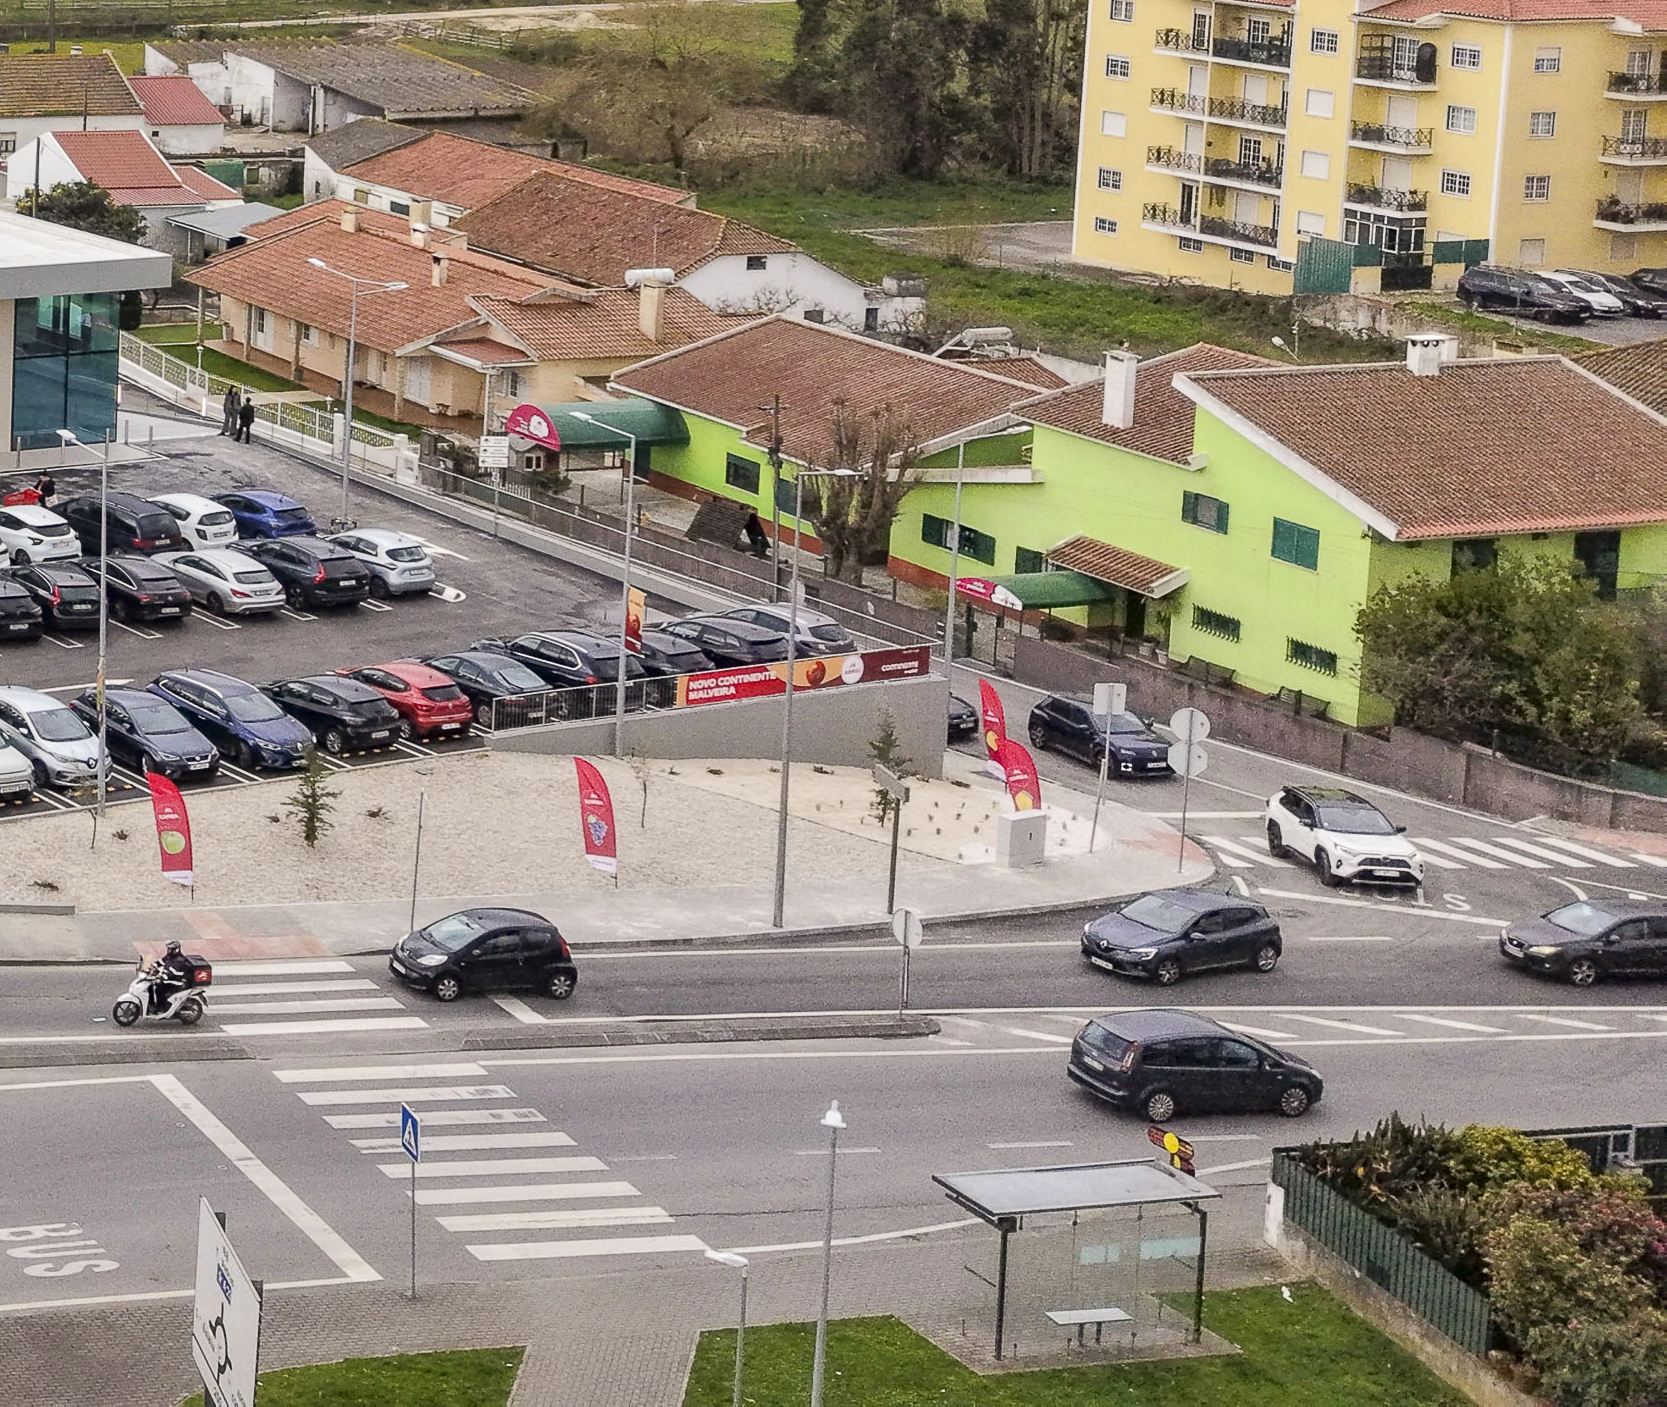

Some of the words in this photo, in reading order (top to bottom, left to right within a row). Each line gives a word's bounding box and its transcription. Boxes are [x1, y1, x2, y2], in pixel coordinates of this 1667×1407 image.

[689, 676, 717, 691] NOVO
[718, 670, 777, 688] CONTINENTE
[688, 686, 737, 701] MALVEIRA
